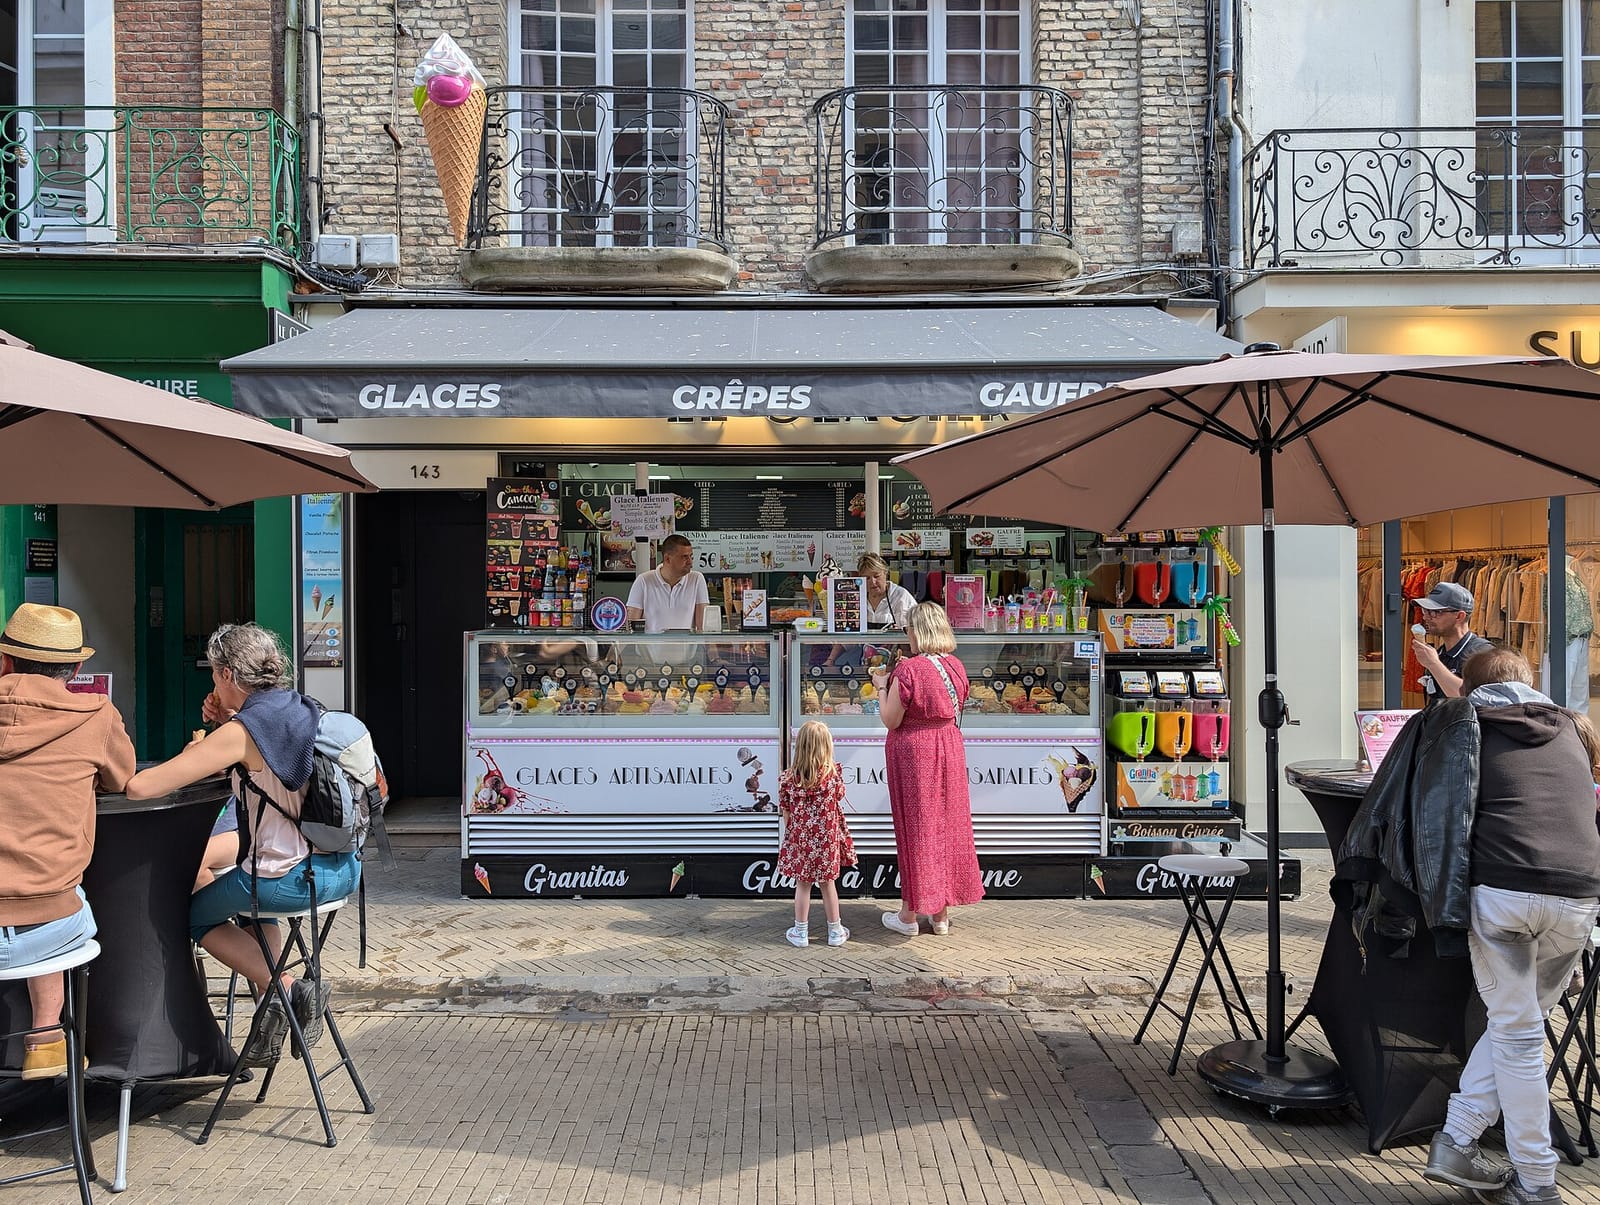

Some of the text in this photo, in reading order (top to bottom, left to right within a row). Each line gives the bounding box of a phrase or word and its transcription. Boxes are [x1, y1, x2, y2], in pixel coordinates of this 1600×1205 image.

[358, 382, 502, 410] GLACES
[672, 378, 812, 411] CRÊPES
[410, 465, 440, 479] 143
[614, 495, 670, 504] Glace Italienne
[33, 511, 46, 522] 141
[699, 552, 717, 568] 5€
[515, 766, 733, 786] GLACES ARTISANALES
[1127, 822, 1225, 839] Boisson Givrée
[523, 862, 630, 894] Granitas
[841, 863, 863, 889] à
